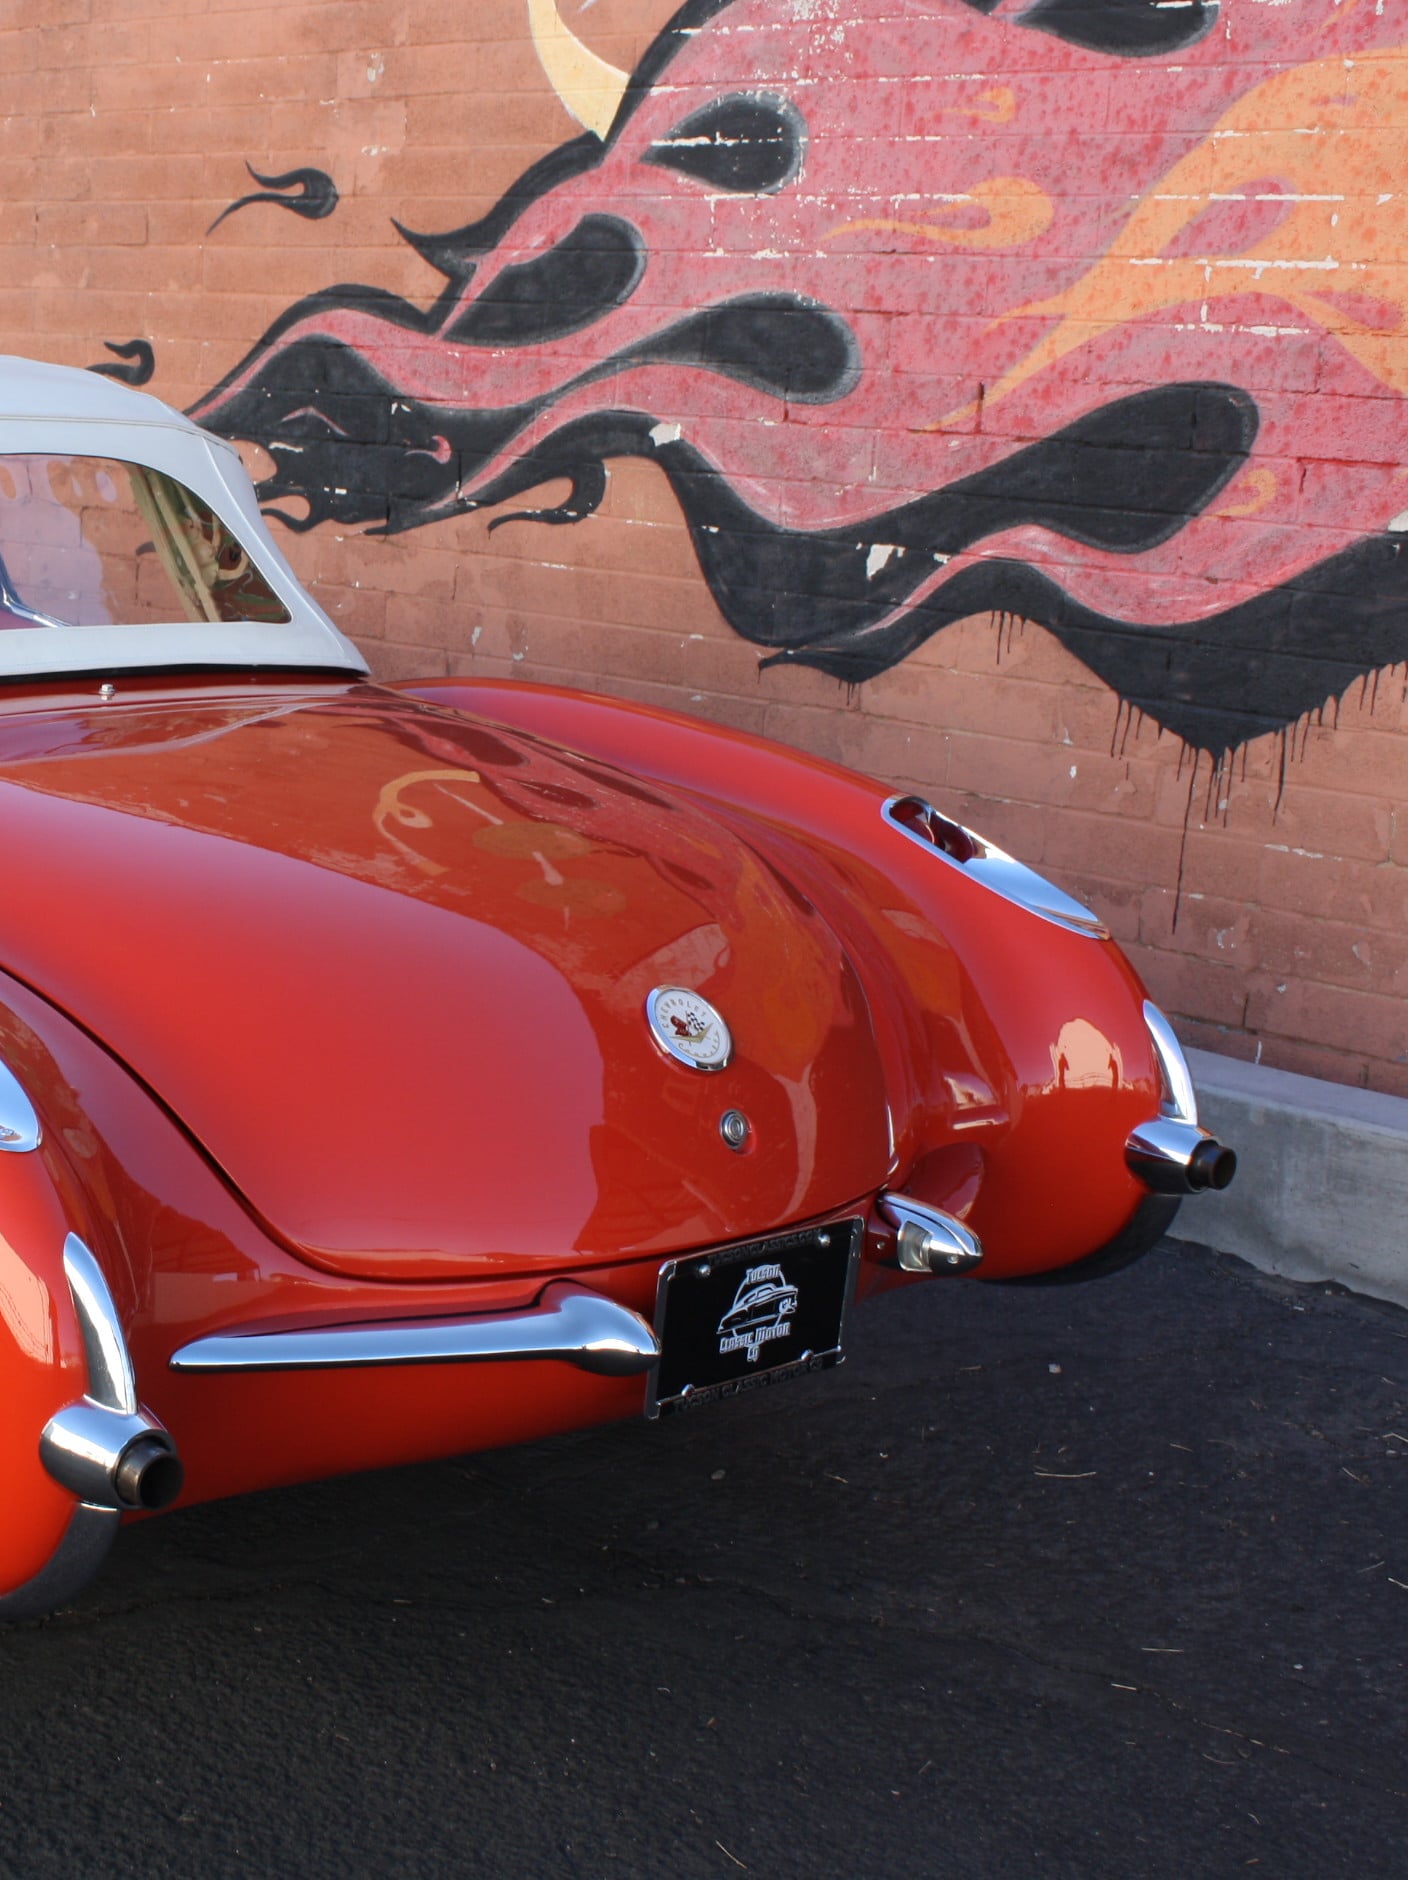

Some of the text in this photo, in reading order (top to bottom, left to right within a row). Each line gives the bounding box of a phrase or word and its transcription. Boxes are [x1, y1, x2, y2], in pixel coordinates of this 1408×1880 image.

[661, 998, 706, 1028] CHEVROLET
[722, 1376, 768, 1396] CLASSIC
[769, 1364, 807, 1384] MOTOR
